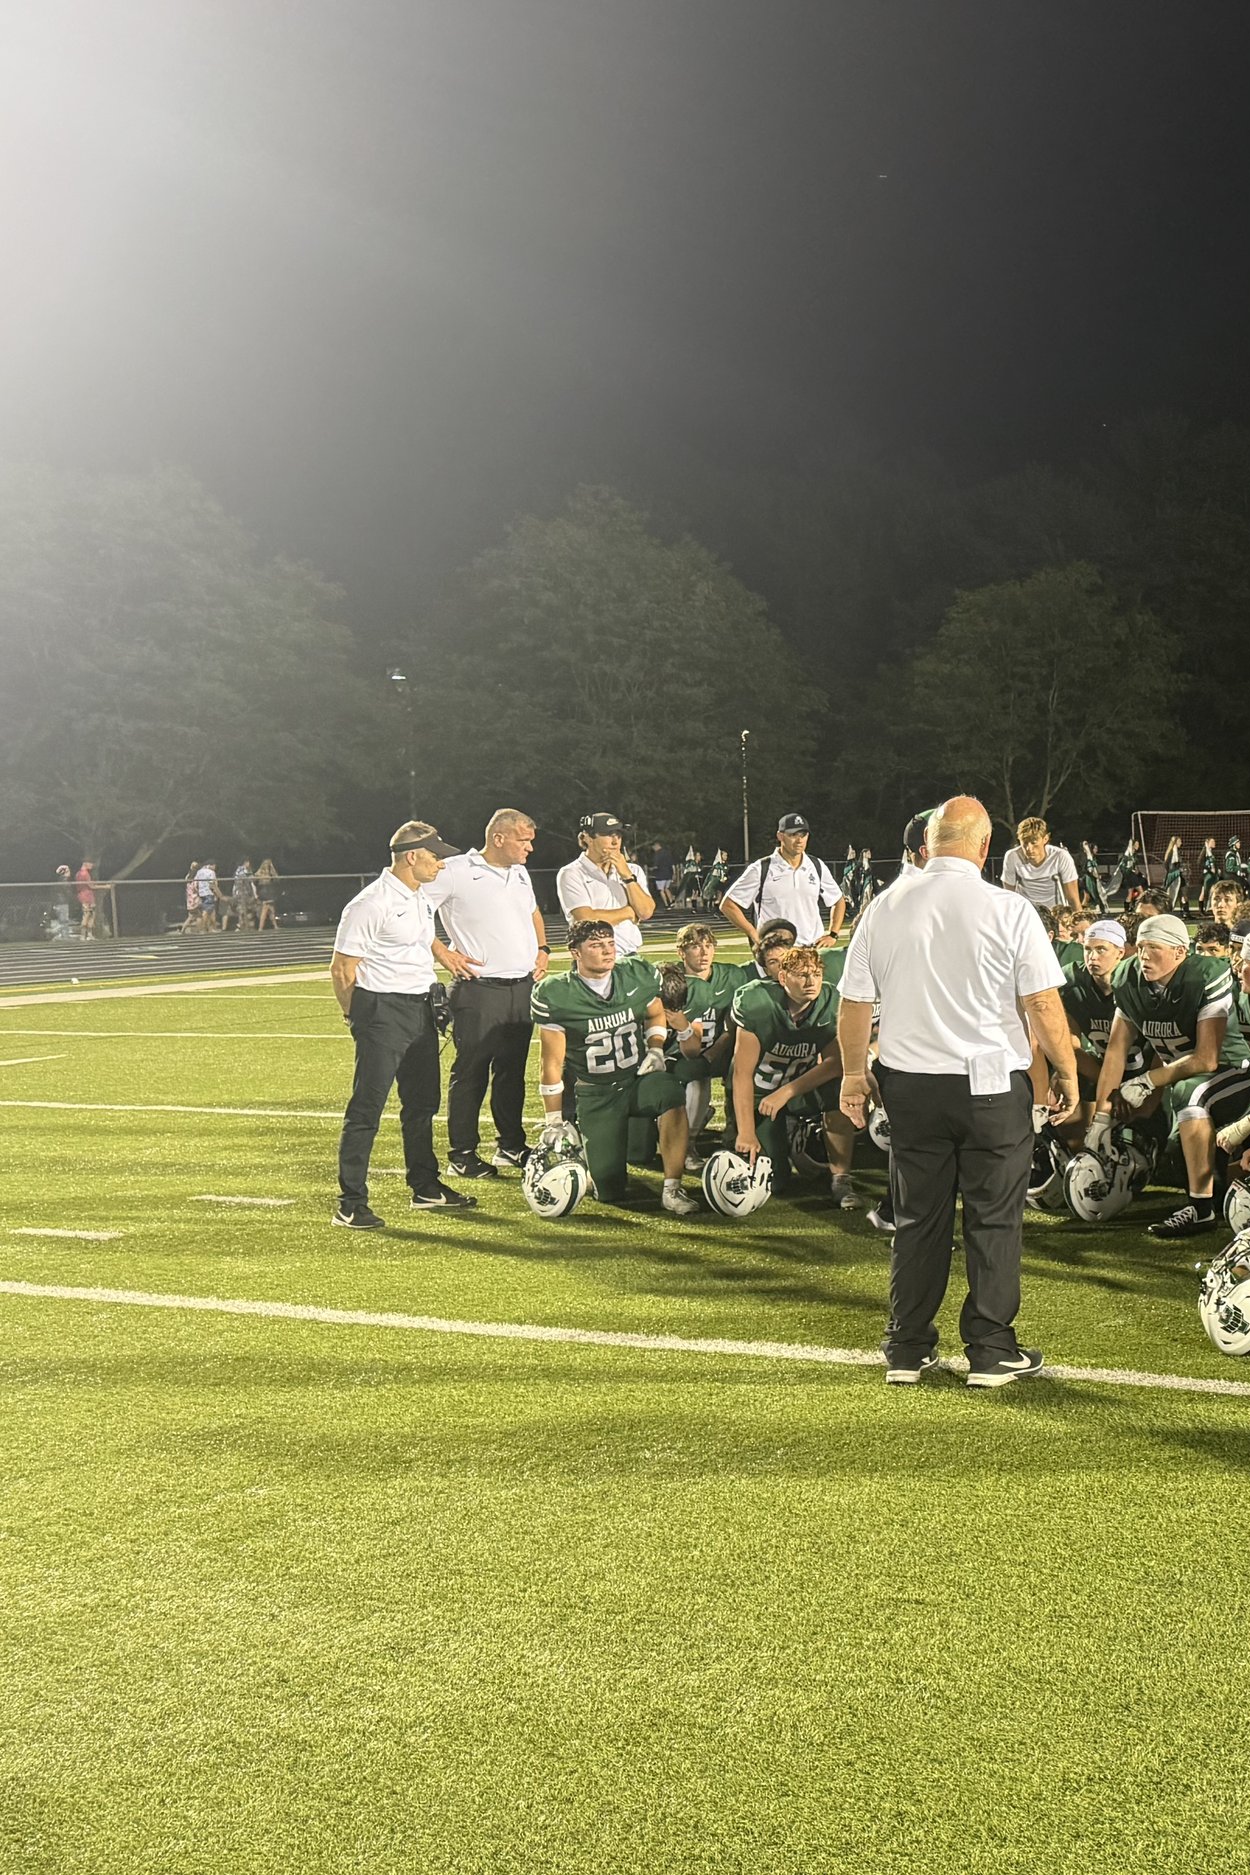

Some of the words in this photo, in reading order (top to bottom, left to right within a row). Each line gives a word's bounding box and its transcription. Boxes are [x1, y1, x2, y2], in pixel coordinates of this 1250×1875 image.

[588, 1007, 635, 1033] AURORA
[1090, 1019, 1110, 1032] AUR
[1142, 1020, 1182, 1038] AURORA
[585, 1022, 639, 1074] 20
[771, 1042, 817, 1057] AURORA
